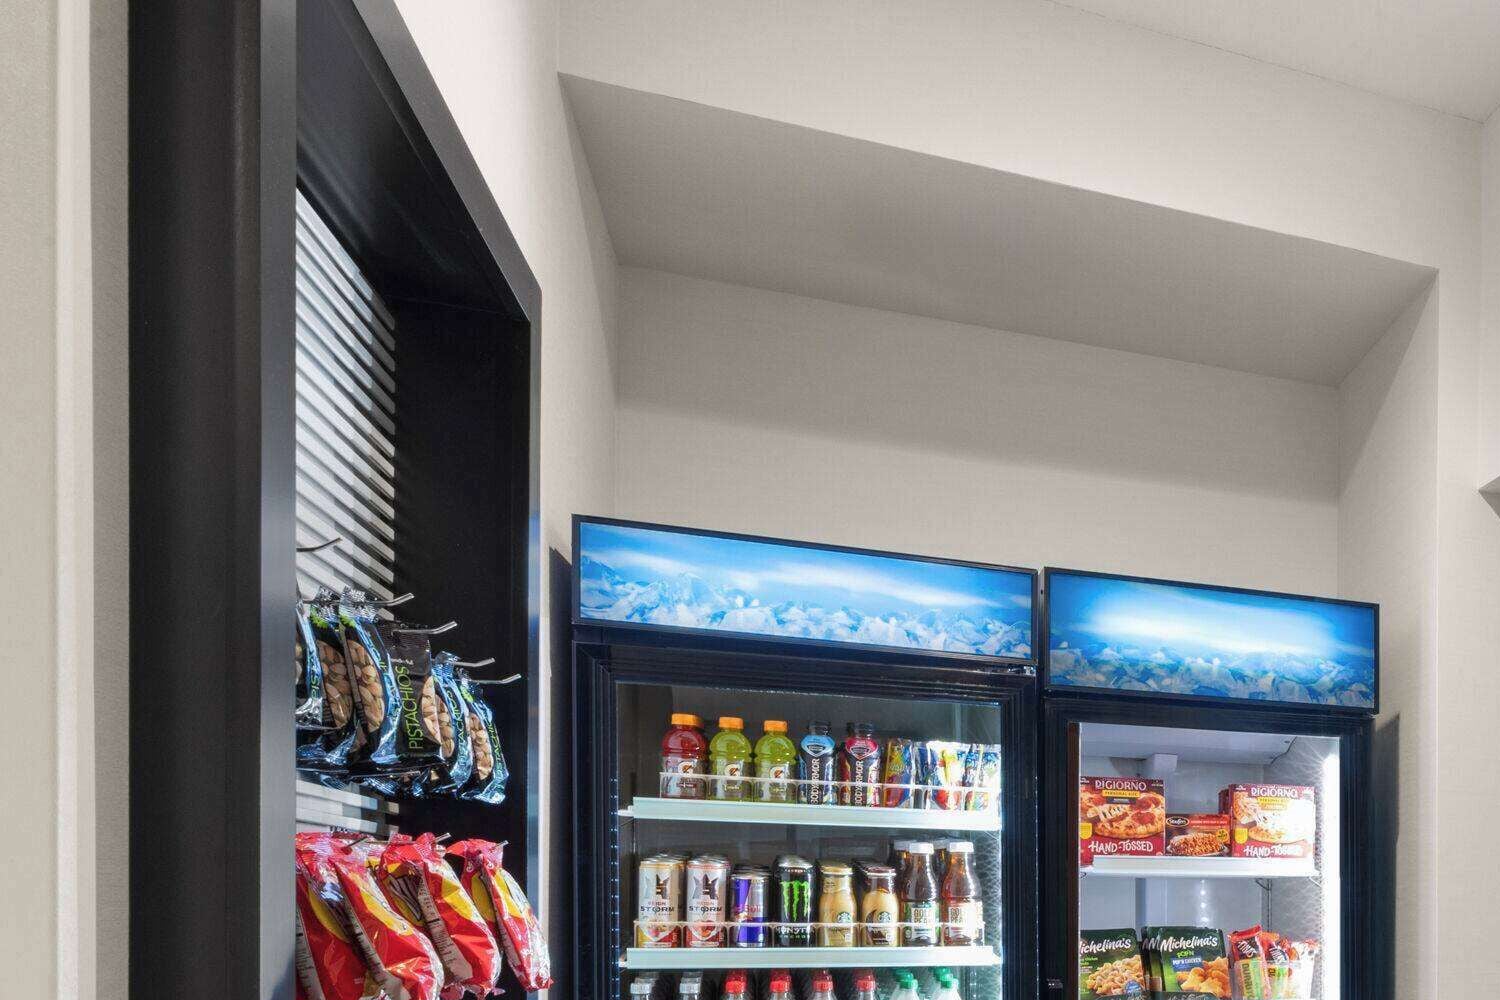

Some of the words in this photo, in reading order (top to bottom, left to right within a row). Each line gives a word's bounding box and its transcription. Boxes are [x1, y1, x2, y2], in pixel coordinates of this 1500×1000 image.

[395, 665, 424, 749] PISTACHIOS
[810, 758, 820, 804] BODYRMOR
[1095, 780, 1147, 791] DIGIORNO
[1088, 840, 1154, 854] HAND-TOSSED
[640, 905, 675, 913] STORM
[689, 905, 722, 913] STORM
[1160, 936, 1218, 952] Michelina's
